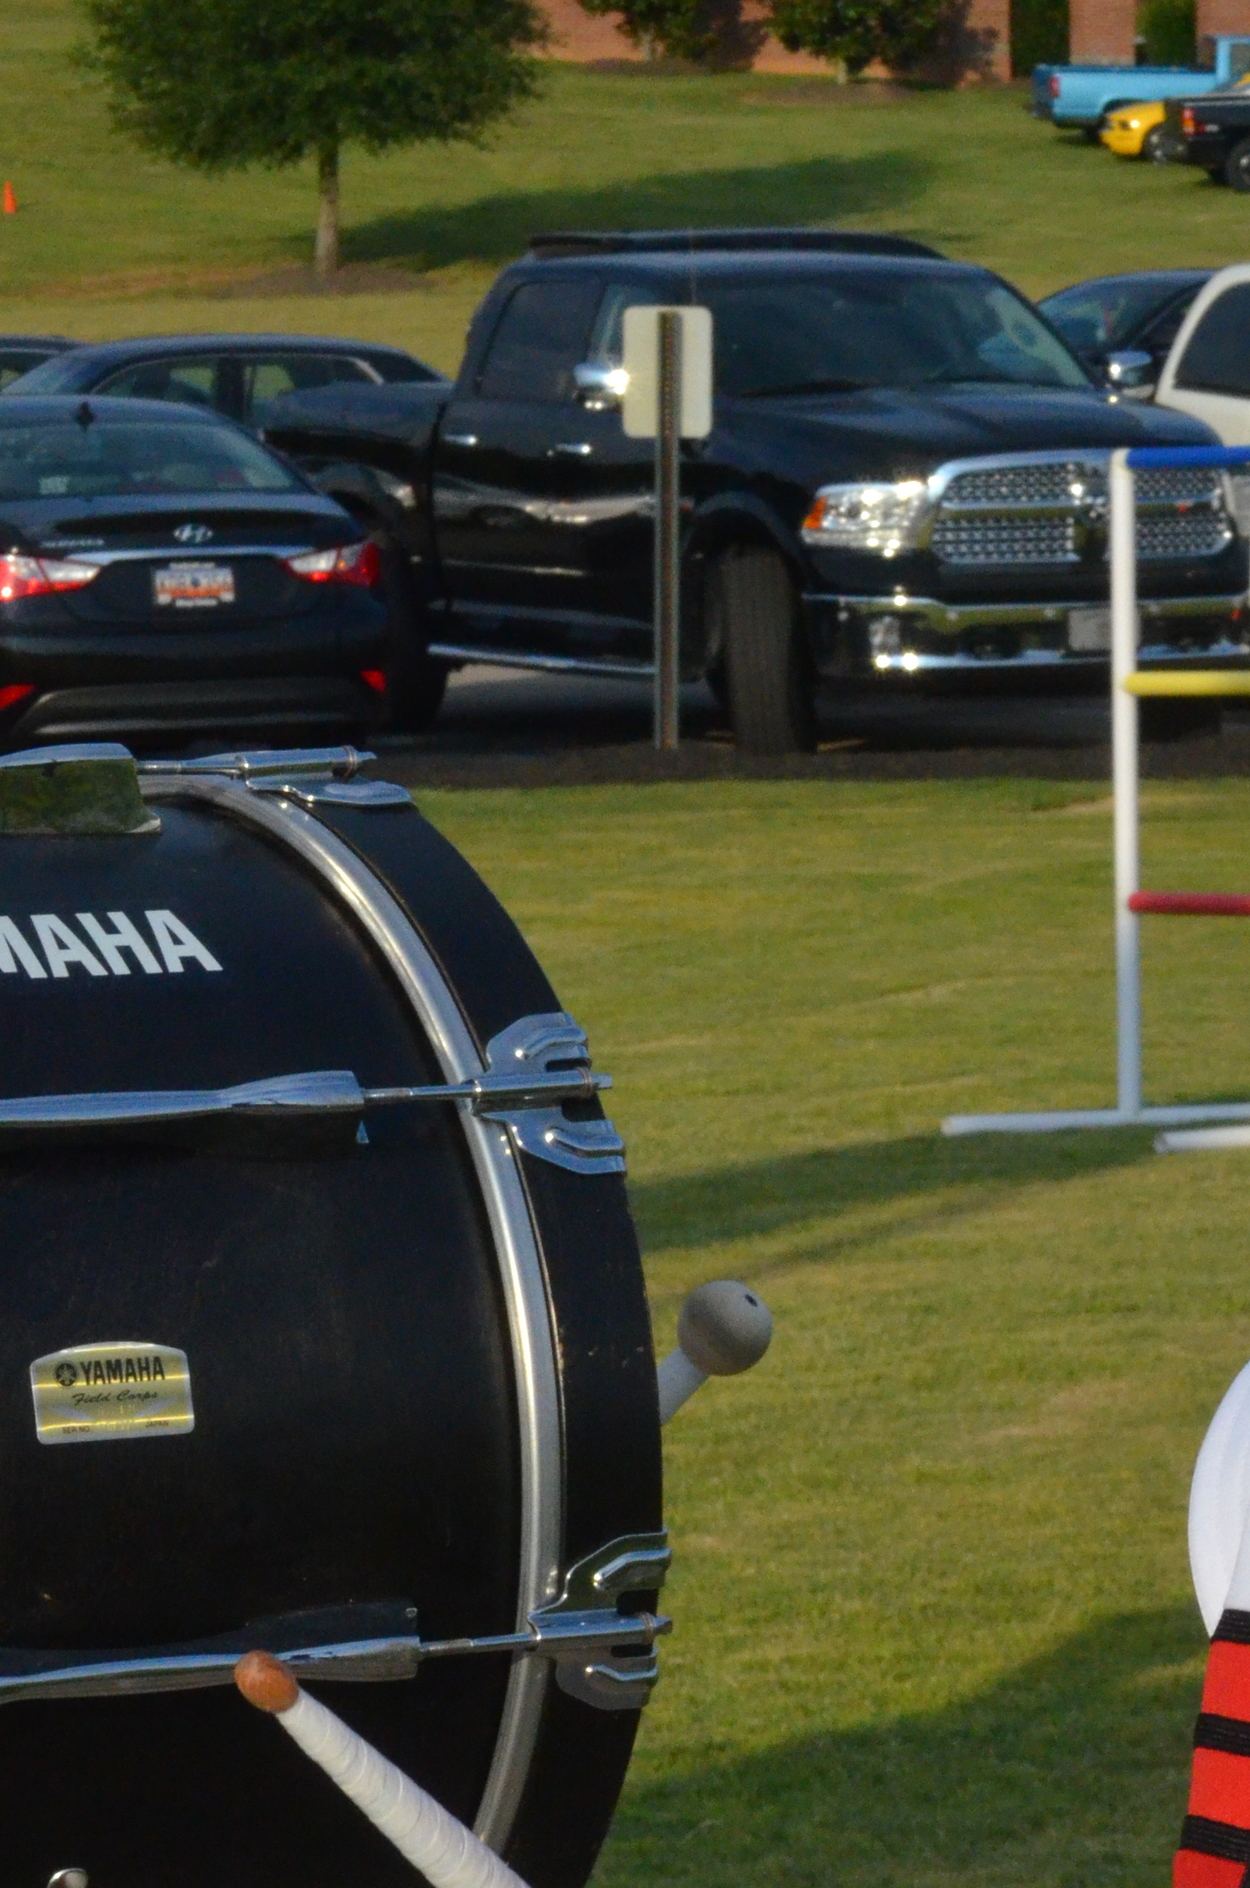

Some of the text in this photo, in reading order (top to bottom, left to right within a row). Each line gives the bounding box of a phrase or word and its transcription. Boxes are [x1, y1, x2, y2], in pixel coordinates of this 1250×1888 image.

[79, 1355, 166, 1386] YAMAHA
[71, 1389, 159, 1407] Field Corps
